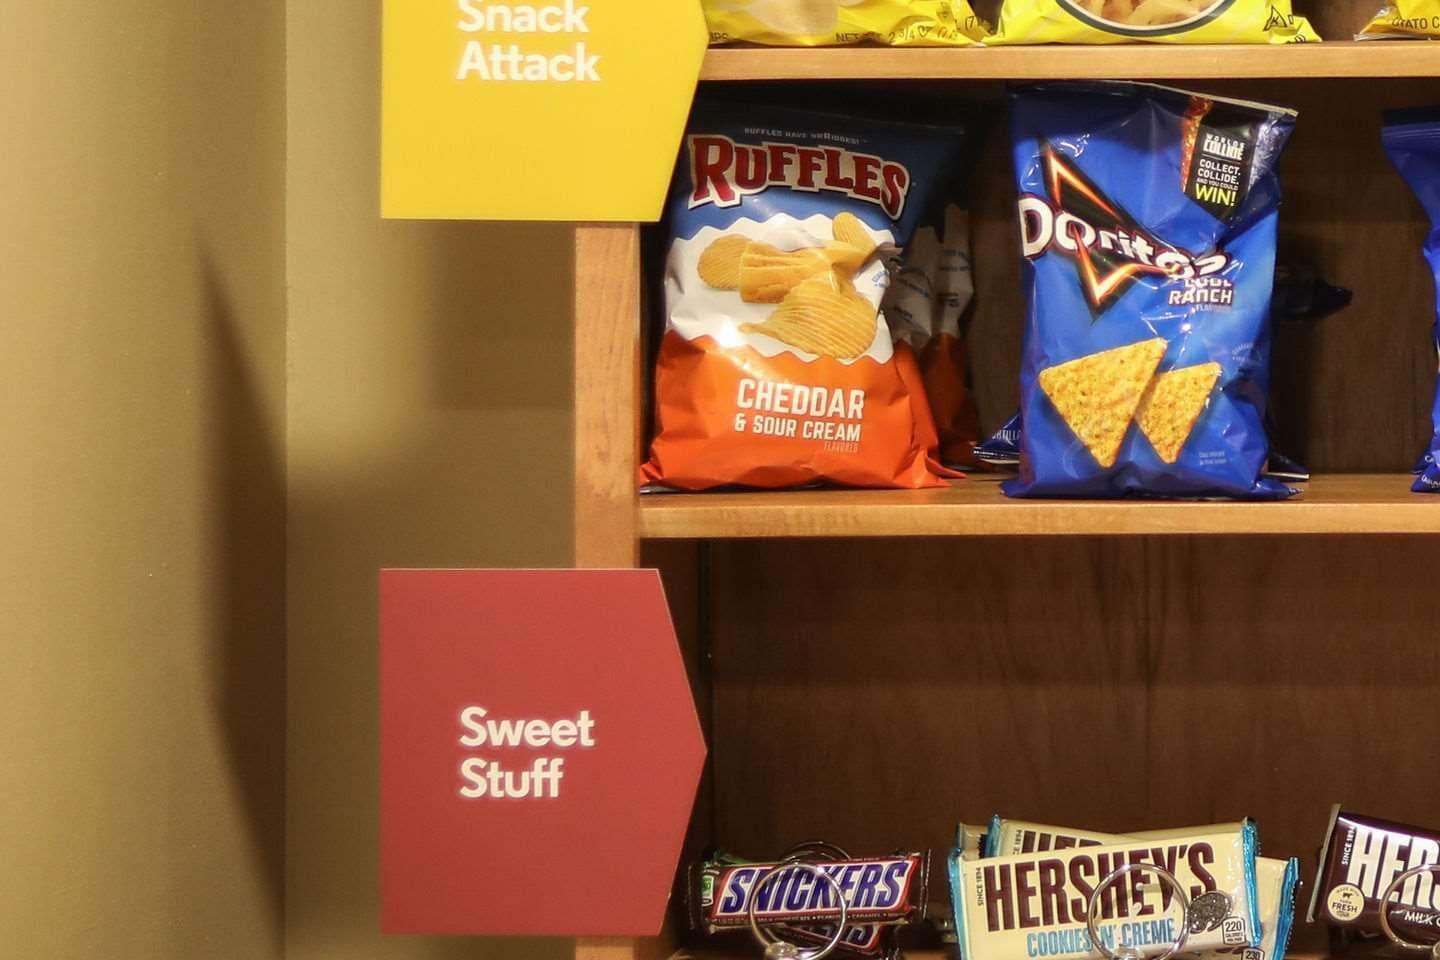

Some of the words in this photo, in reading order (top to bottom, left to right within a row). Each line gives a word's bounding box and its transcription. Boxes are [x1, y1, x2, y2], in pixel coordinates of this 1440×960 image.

[456, 41, 601, 81] Attack
[690, 136, 908, 218] RUFFLES
[1196, 183, 1236, 207] WIN!
[1169, 289, 1233, 305] RANCH
[737, 378, 865, 420] CHEDDAR
[734, 413, 746, 432] &
[752, 416, 796, 439] SOUR
[802, 420, 861, 442] CREAM
[460, 706, 595, 747] Sweet
[460, 757, 565, 799] Stuff
[1341, 840, 1353, 865] SINCE
[721, 862, 911, 914] SNICKERS
[976, 882, 984, 906] SINCE
[983, 842, 1218, 932] HERSHEY'S
[1332, 902, 1358, 913] FRESH
[1404, 911, 1434, 926] MILK
[1027, 927, 1094, 958] COOKIES
[1120, 917, 1176, 948] CREME
[1225, 920, 1242, 932] 220
